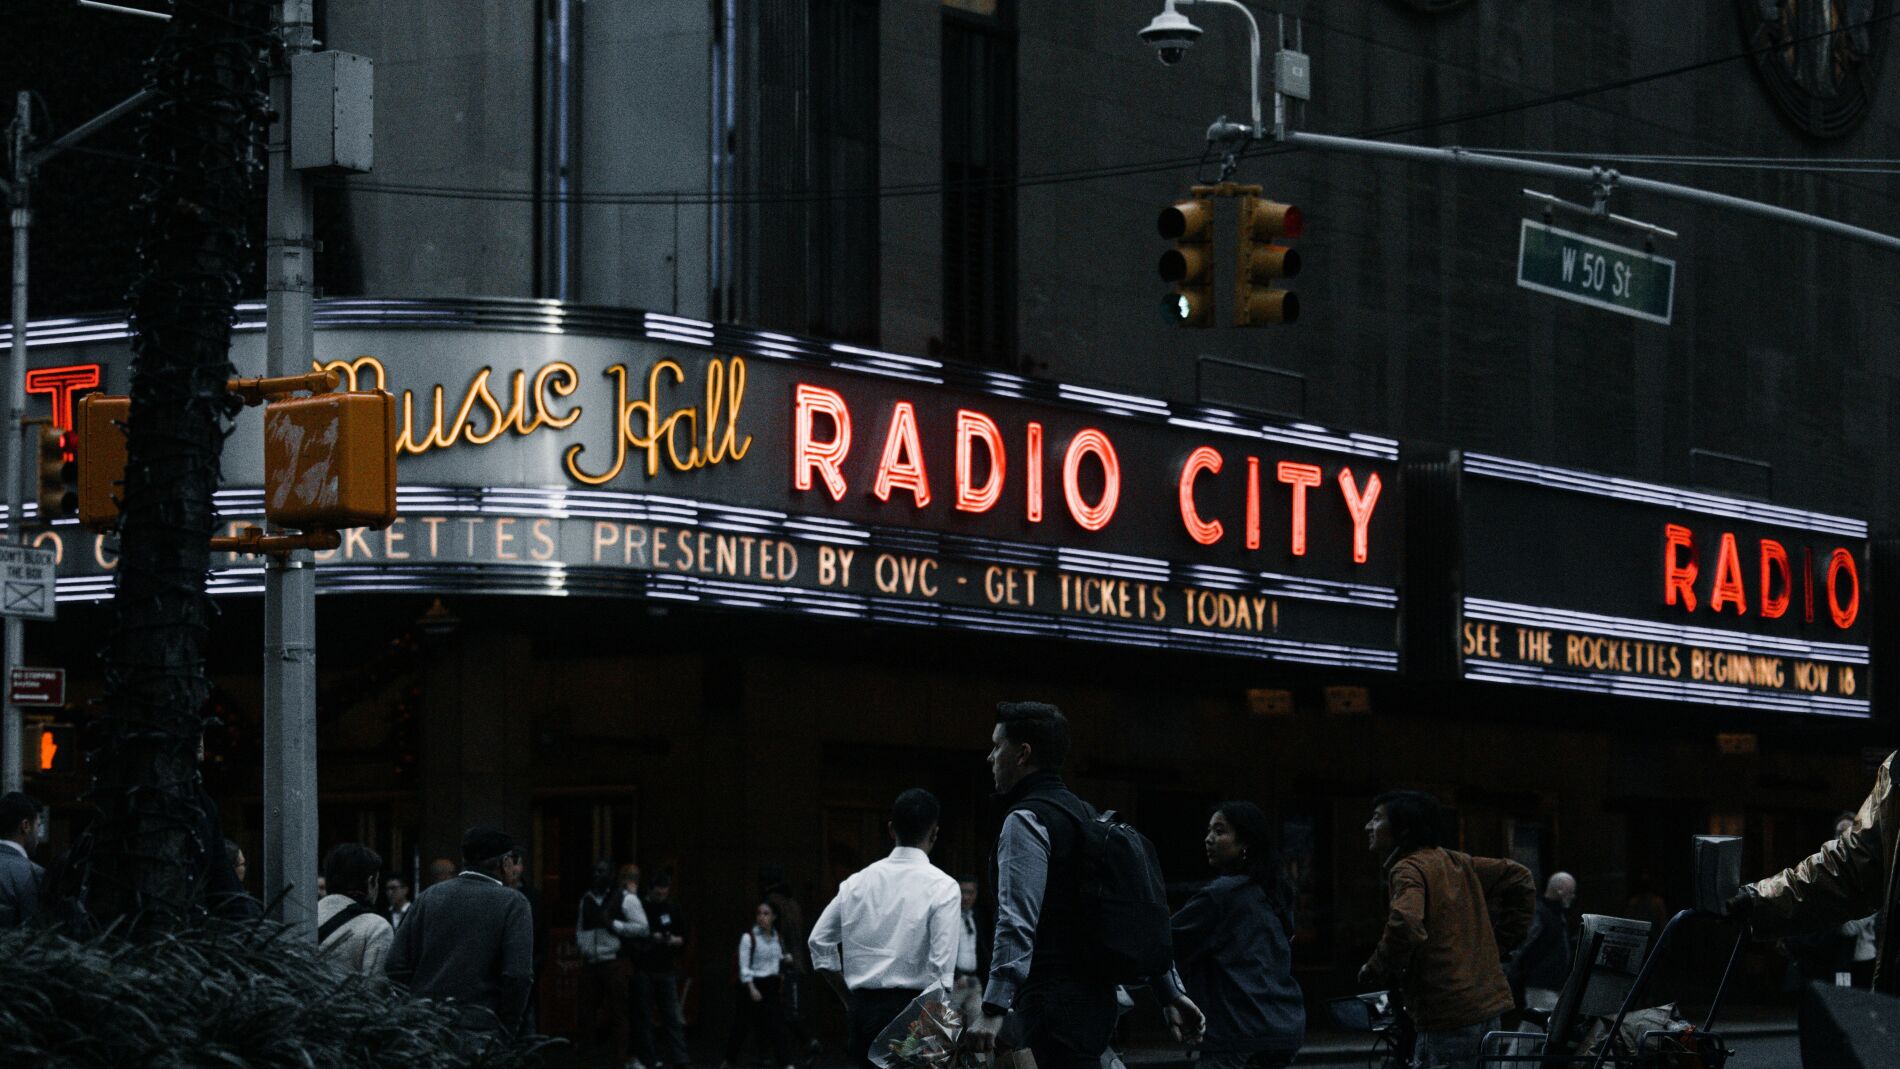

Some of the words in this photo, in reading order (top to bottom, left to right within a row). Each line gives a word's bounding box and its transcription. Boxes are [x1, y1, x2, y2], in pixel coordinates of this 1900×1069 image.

[1562, 246, 1577, 283] W
[1582, 252, 1606, 291] 50
[1612, 260, 1632, 298] St
[566, 356, 752, 484] Hall
[795, 383, 1121, 531] RADIO
[1179, 446, 1382, 564] CITY
[593, 520, 799, 581] PRESENTED
[818, 545, 854, 587] BY
[874, 553, 939, 597] QVC
[984, 565, 1038, 607] GET
[1058, 574, 1167, 622] TICKETS
[1182, 588, 1280, 634] TODAY!
[1664, 522, 1860, 629] RADIO
[1463, 623, 1500, 658] SEE
[1517, 628, 1552, 664] THE
[1566, 634, 1681, 678] ROCKETTES
[1691, 652, 1785, 688] BEGINNING
[1793, 662, 1829, 694] NOV
[1838, 666, 1857, 695] 18
